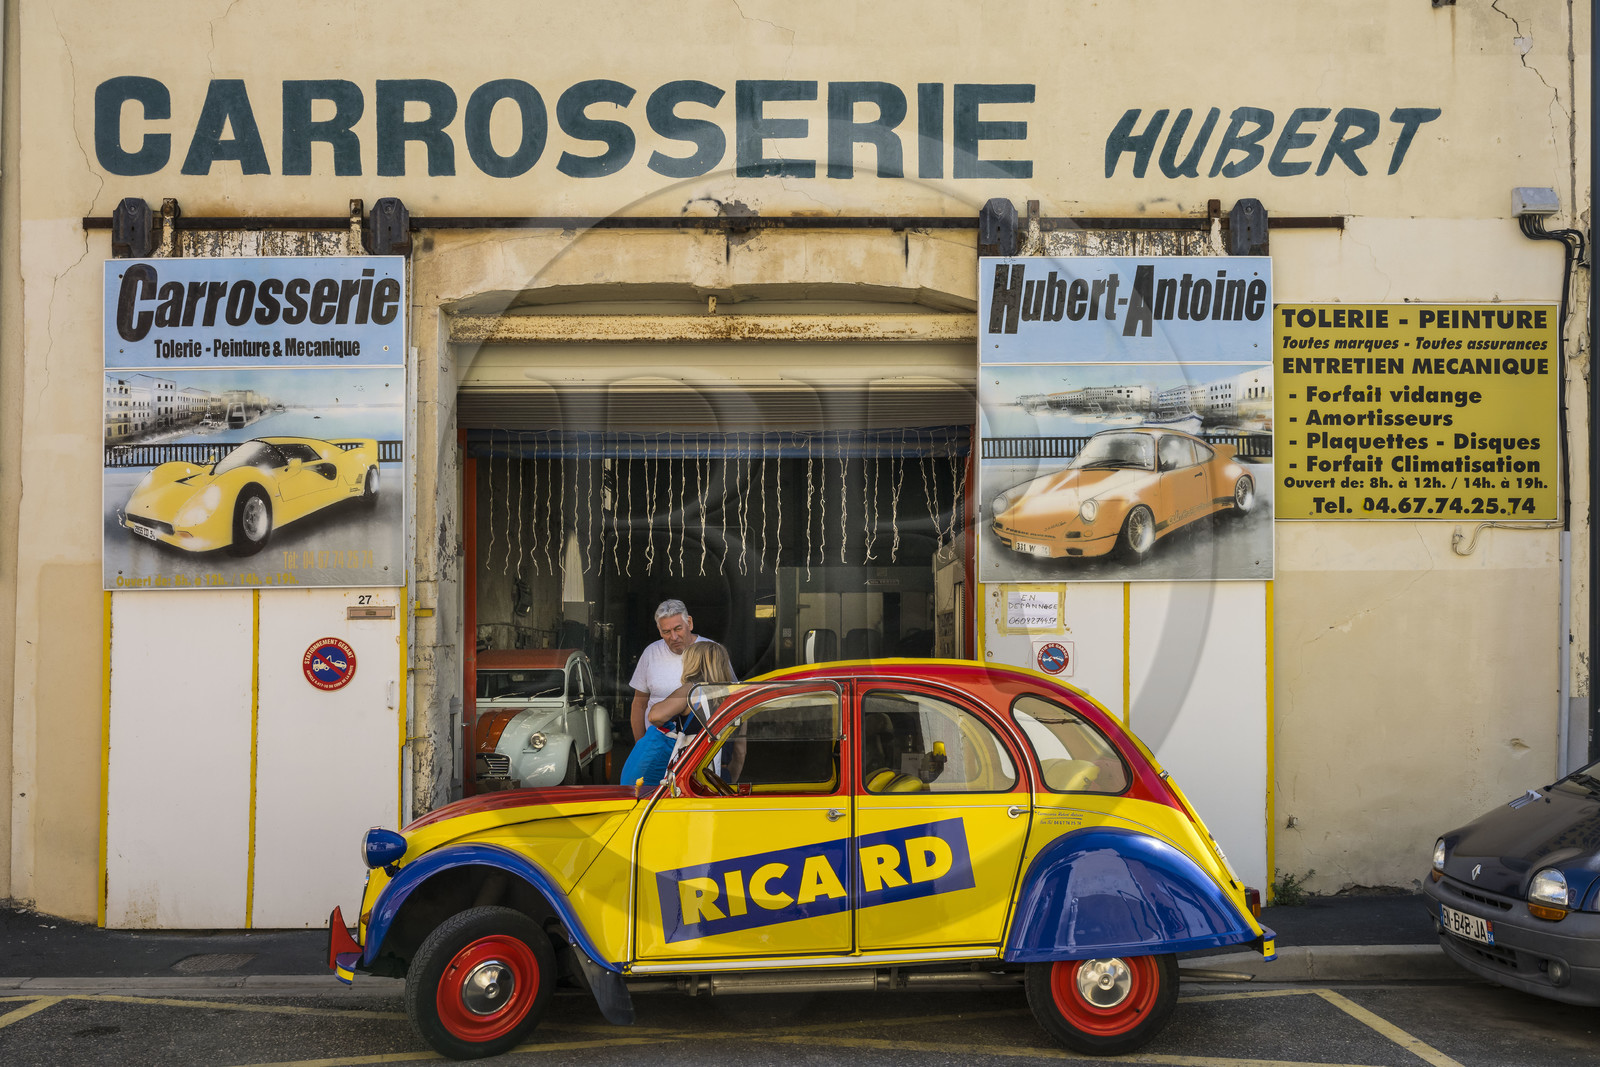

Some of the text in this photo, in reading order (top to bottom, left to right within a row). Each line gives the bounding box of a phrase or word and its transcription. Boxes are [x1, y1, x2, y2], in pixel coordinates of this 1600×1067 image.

[94, 76, 1035, 180] CARROSSERIE
[1105, 107, 1441, 180] HUBERT
[116, 263, 400, 343] Carrosserie
[988, 264, 1268, 337] Hubert-Antoine
[1282, 309, 1389, 329] TOLERIE
[1419, 310, 1547, 330] PEINTURE
[154, 339, 202, 359] Tolerie
[213, 339, 271, 358] Peinture
[273, 341, 282, 358] &
[285, 337, 361, 359] Mecanique
[1282, 336, 1330, 350] Toutes
[1334, 339, 1399, 353] marques
[1416, 337, 1462, 351] Toutes
[1466, 340, 1548, 351] assurances
[1282, 357, 1549, 376] ENTRETIEN MECANIQUE
[1306, 385, 1382, 403] Forfait
[1390, 385, 1483, 408] vidange
[1306, 408, 1454, 427] Amortisseurs
[1306, 432, 1429, 454] Plaquettes
[1453, 432, 1541, 454] Disques
[1306, 455, 1384, 473] Forfait
[1391, 455, 1541, 473] Climatisation
[1284, 476, 1549, 489] Ouvert de: 8h. à 12h. / 14h. à 19h.
[1313, 497, 1536, 514] Tel. 04.67.74.25.74
[303, 550, 315, 569] 04
[318, 550, 330, 569] 67
[333, 550, 345, 569] 74
[347, 550, 359, 569] 25
[362, 550, 374, 569] 74
[116, 575, 152, 587] Ouvert
[155, 573, 172, 587] de:
[175, 574, 192, 586] 8h.
[205, 573, 229, 586] 12h.
[240, 572, 263, 585] 14h.
[276, 571, 299, 584] 19h.
[358, 594, 372, 605] 27
[1020, 594, 1036, 602] EN
[304, 639, 339, 665] STATIONNEMENT
[678, 836, 953, 926] RICARD
